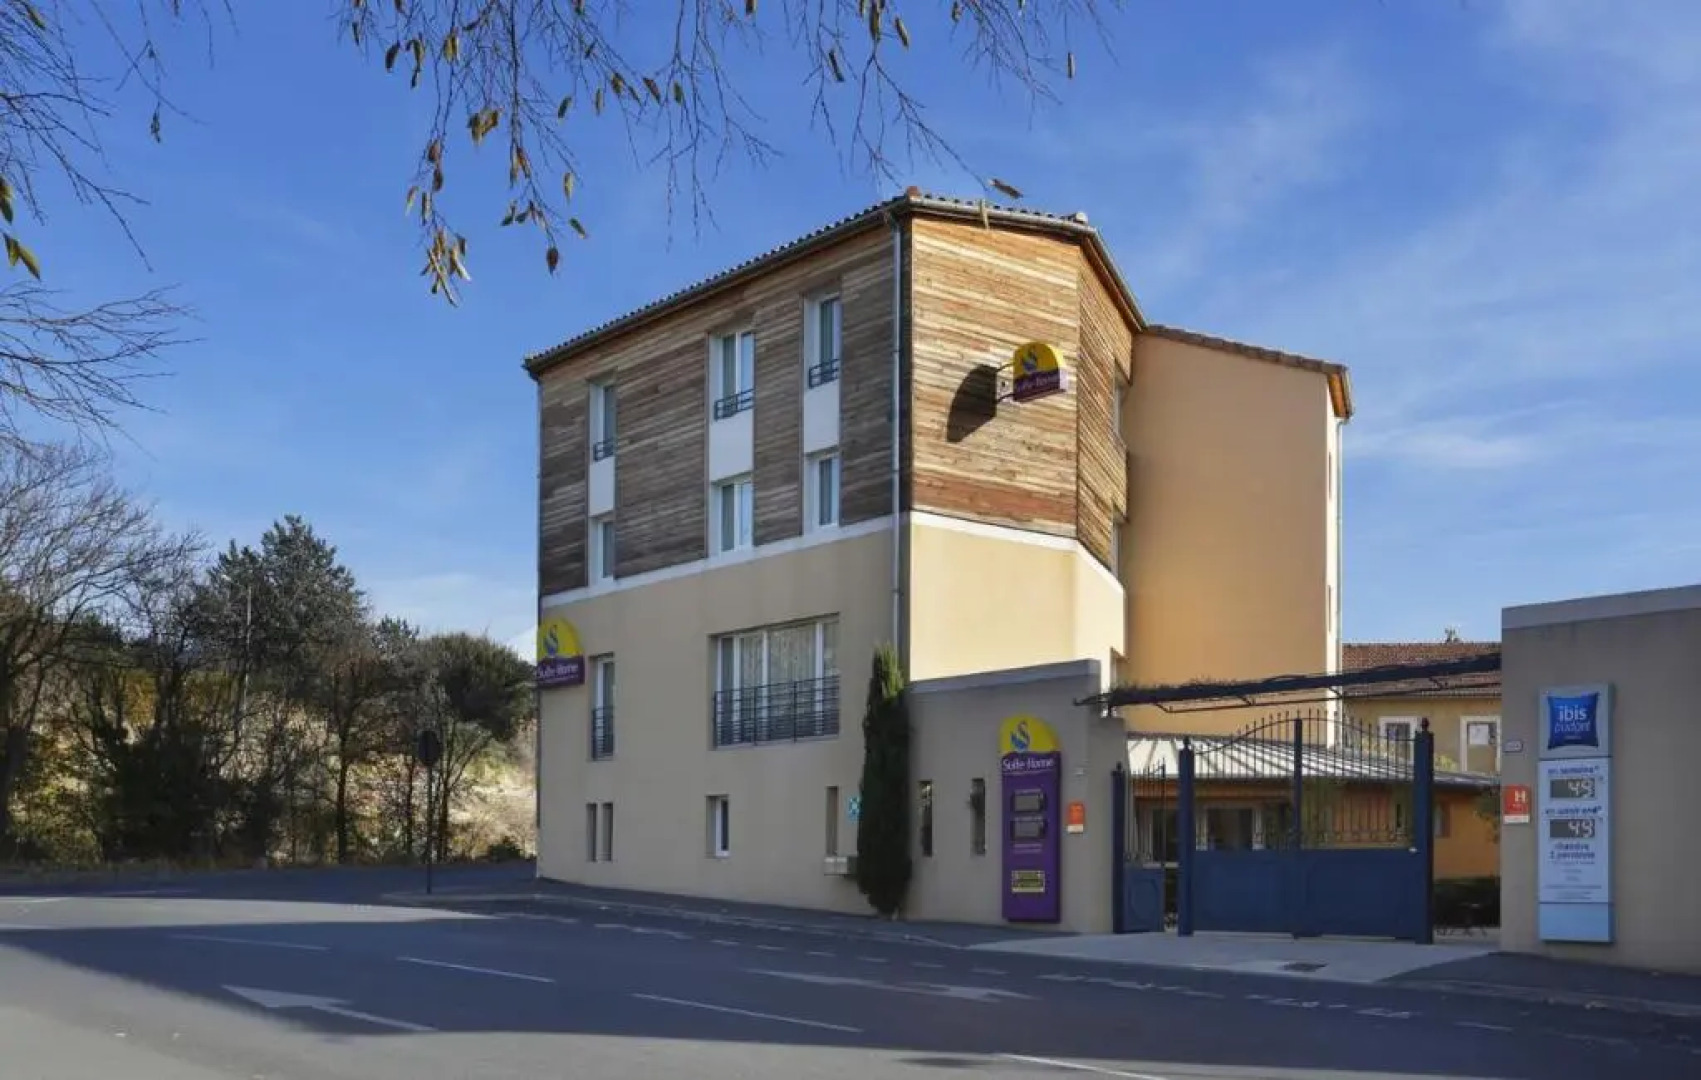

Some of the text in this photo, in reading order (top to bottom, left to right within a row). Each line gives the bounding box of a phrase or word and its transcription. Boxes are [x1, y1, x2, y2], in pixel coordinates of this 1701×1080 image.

[1559, 704, 1588, 721] ibis
[1514, 790, 1526, 803] H
[1568, 779, 1593, 798] 49
[1568, 819, 1593, 838] 49
